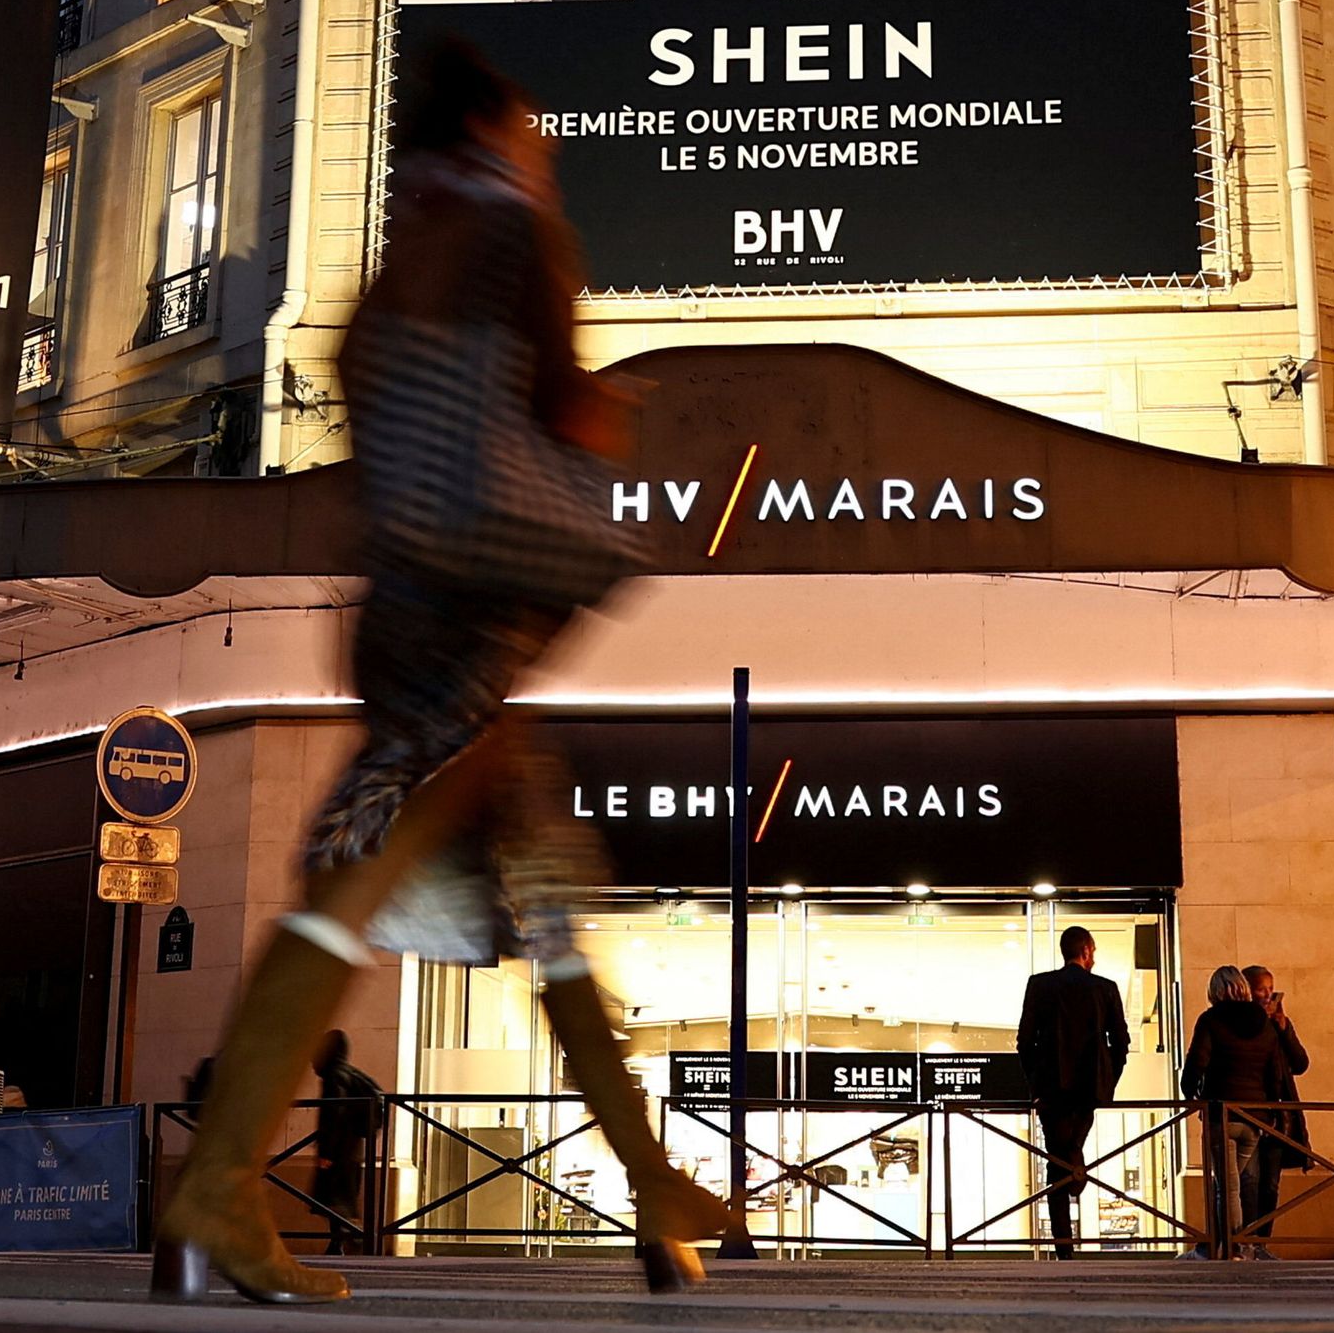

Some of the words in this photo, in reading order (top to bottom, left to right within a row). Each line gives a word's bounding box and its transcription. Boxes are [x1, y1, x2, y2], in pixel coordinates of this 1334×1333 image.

[648, 21, 933, 87] SHEIN
[685, 105, 879, 134] OUVERTURE
[890, 99, 1062, 129] MONDIALE
[661, 146, 697, 171] LE
[708, 145, 726, 170] 5
[737, 140, 919, 169] NOVEMBRE
[734, 208, 844, 254] BHV
[756, 258, 776, 266] RUE
[786, 257, 799, 265] DE
[810, 256, 844, 264] RIVOLI
[612, 481, 701, 522] HV
[758, 477, 1045, 522] MARAIS
[574, 786, 628, 817] LE
[794, 783, 1003, 818] MARAIS
[170, 932, 182, 943] RUE
[684, 1071, 731, 1084] SHEIN
[833, 1066, 913, 1086] SHEIN
[934, 1072, 982, 1085] SHEIN
[37, 1159, 58, 1169] PARIS
[14, 1182, 24, 1203] À
[28, 1185, 68, 1204] TRAFIC
[69, 1179, 110, 1203] LIMITÉ
[13, 1208, 42, 1222] PARIS
[43, 1207, 71, 1222] CENTRE
